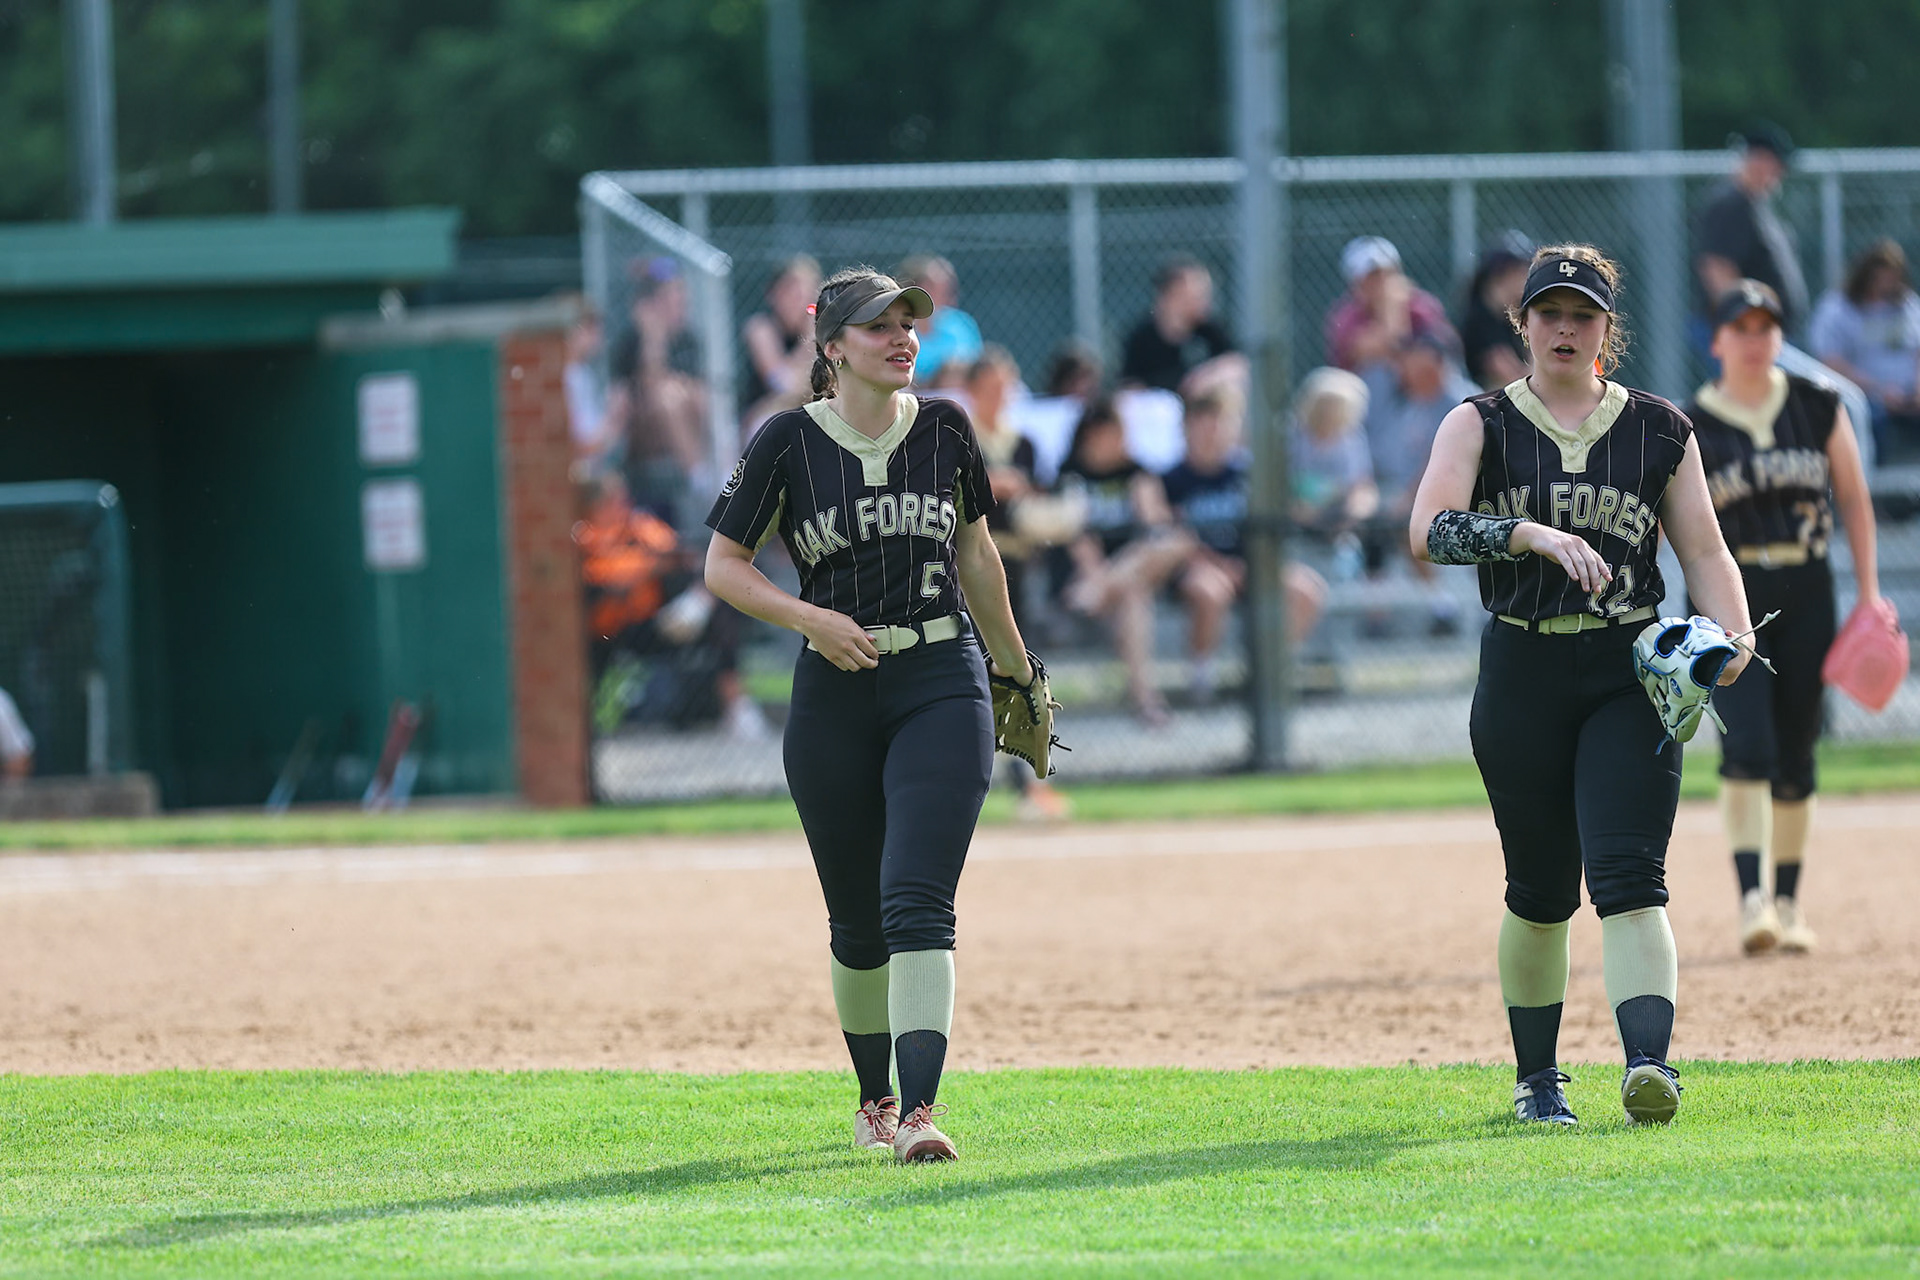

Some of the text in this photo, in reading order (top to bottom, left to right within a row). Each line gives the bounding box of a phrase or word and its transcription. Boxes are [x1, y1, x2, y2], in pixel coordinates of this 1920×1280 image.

[1559, 261, 1578, 278] OF
[855, 493, 957, 549] FORES
[1550, 482, 1658, 547] FORES
